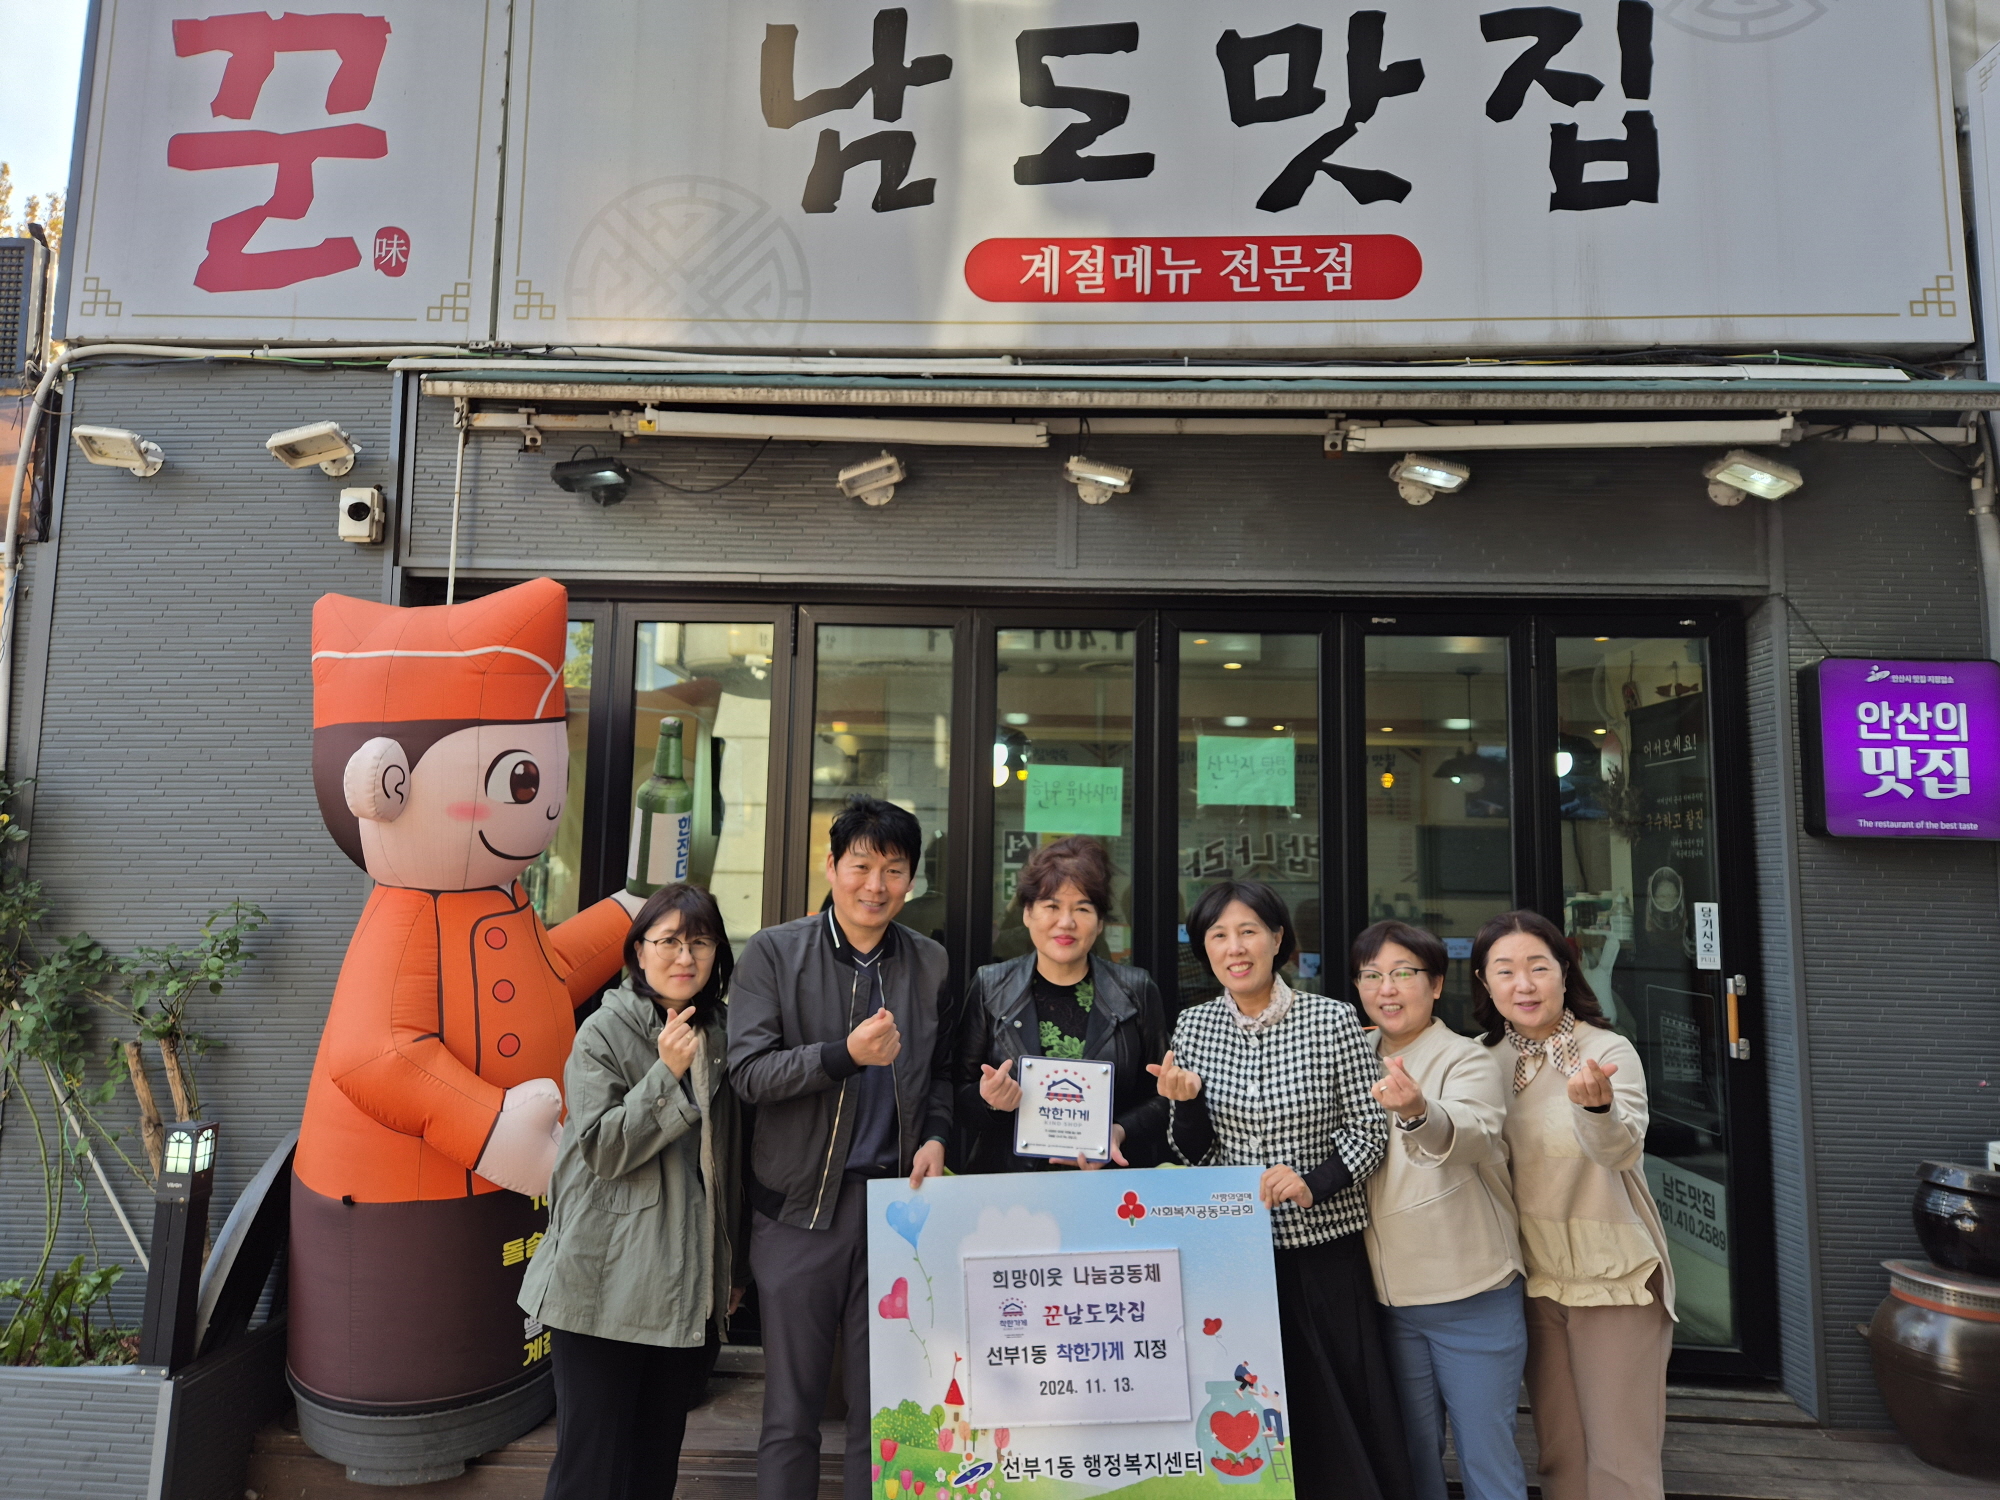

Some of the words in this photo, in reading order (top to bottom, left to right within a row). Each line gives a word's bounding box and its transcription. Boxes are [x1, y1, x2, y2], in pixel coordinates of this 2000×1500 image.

[760, 0, 1659, 213] 남도맛집
[167, 11, 392, 293] 꾼
[375, 233, 408, 268] 味
[1020, 244, 1201, 295] 계절메뉴
[1219, 242, 1353, 293] 전문점
[1857, 701, 1968, 742] 안산의
[1644, 733, 1697, 758] 어서오세요!
[1207, 754, 1255, 780] 산낙지
[1261, 755, 1287, 776] 탕탕
[1857, 746, 1971, 799] 맛집
[1858, 818, 1873, 828] The
[1875, 820, 1914, 829] restaurant
[1916, 820, 1924, 829] of
[1925, 820, 1938, 829] the
[1940, 821, 1957, 830] best
[1959, 821, 1978, 830] taste
[1701, 906, 1714, 953] 당기시오
[1039, 1106, 1090, 1121] 착한가게
[1063, 1121, 1083, 1129] SHOP
[1662, 1173, 1716, 1220] 남도맛집
[1151, 1204, 1253, 1219] 사회복지공동모금회
[993, 1268, 1063, 1289] 희망이웃
[1073, 1263, 1161, 1285] 나눔공동체
[1043, 1300, 1145, 1326] 꾼남도맛집
[987, 1345, 1047, 1366] 선부1동
[1056, 1341, 1124, 1362] 착한가게
[1133, 1339, 1167, 1359] 지정
[1039, 1380, 1078, 1395] 2024.
[1086, 1378, 1106, 1393] 11.
[1114, 1377, 1134, 1392] 13.
[1003, 1455, 1076, 1480] 선부1동
[1083, 1451, 1203, 1477] 행정복지센터
